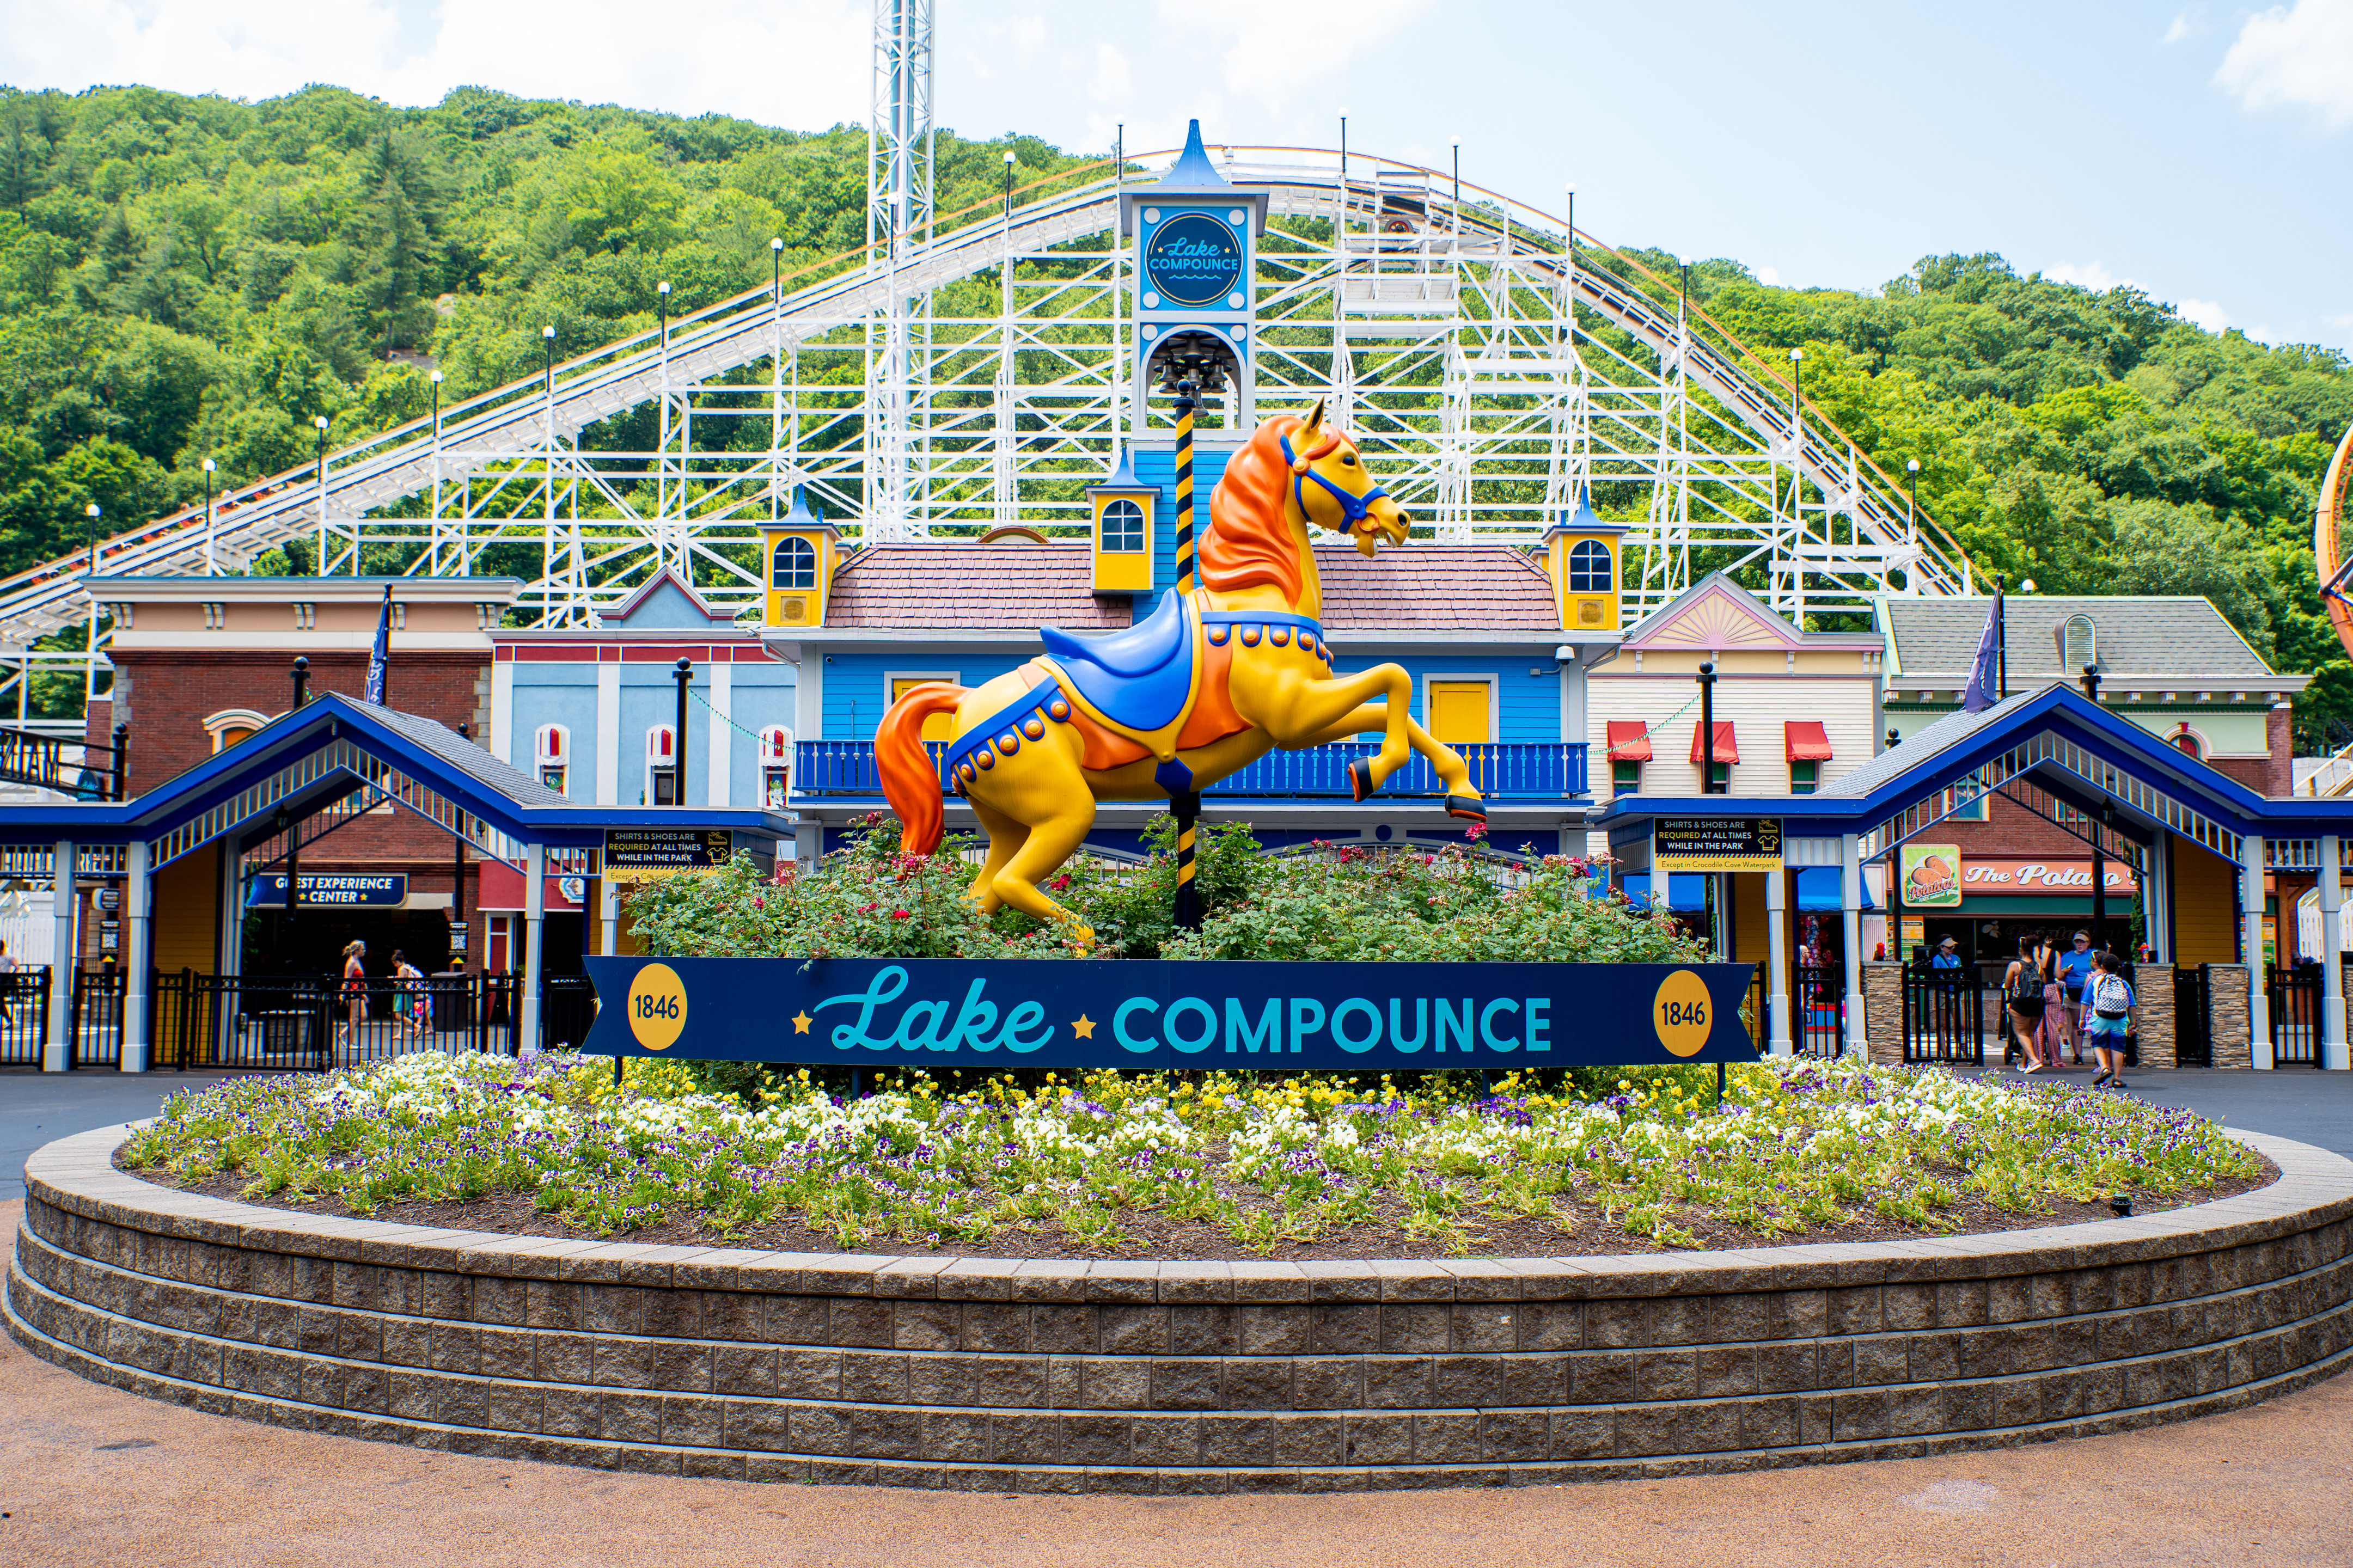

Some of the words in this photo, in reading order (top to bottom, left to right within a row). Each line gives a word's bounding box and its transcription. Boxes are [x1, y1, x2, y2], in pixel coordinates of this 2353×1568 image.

[1163, 237, 1220, 257] Lake
[1150, 259, 1238, 271] COMPOUNCE
[1659, 831, 1700, 840] REQUIRED
[608, 843, 650, 852] REQUIRED
[1661, 861, 1683, 869] Except
[1742, 861, 1776, 869] Waterpark
[316, 878, 393, 889] EXPERIENCE
[1964, 867, 2012, 883] The
[2015, 865, 2122, 886] Potao
[309, 891, 358, 903] CENTER
[1909, 879, 1954, 901] Potatoes
[634, 994, 680, 1019] 1846
[813, 964, 1055, 1053] Lake
[1113, 995, 1551, 1055] COMPOUNCE
[1661, 1001, 1706, 1026] 1846
